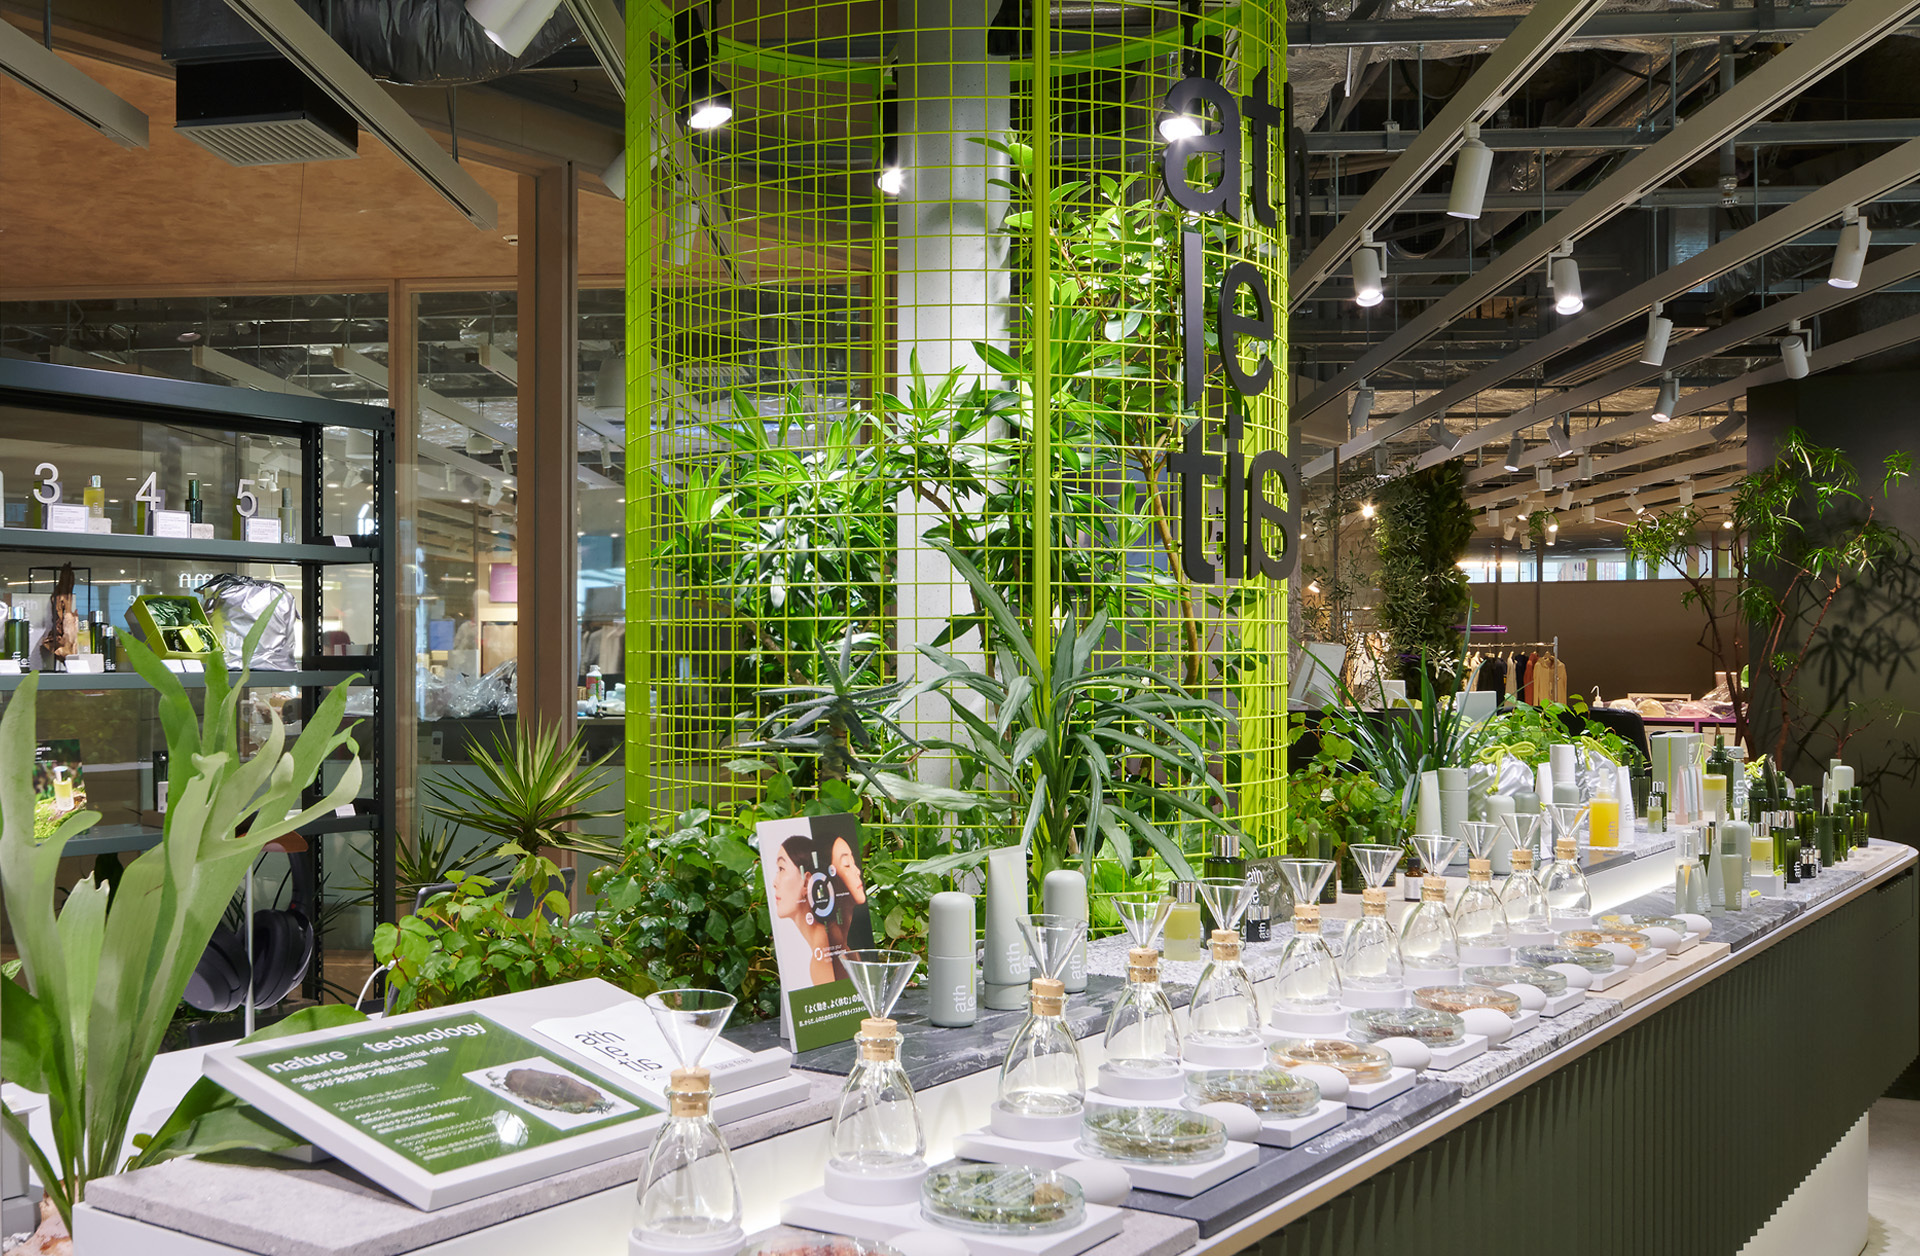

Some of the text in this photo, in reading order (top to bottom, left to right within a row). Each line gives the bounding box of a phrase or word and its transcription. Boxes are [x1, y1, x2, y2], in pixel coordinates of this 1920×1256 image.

[1162, 66, 1309, 256] ath
[1183, 231, 1274, 410] le
[33, 462, 61, 505] 3
[135, 471, 162, 511] 4
[236, 478, 258, 518] 5
[1733, 779, 1745, 805] ath
[1007, 942, 1022, 976] ath
[1070, 954, 1082, 980] ath
[952, 984, 967, 1013] ath
[966, 995, 976, 1012] le
[267, 1049, 348, 1074] nature
[363, 1022, 487, 1053] technology
[574, 1030, 626, 1046] ath
[291, 1069, 331, 1084] natural
[331, 1058, 382, 1078] botanical
